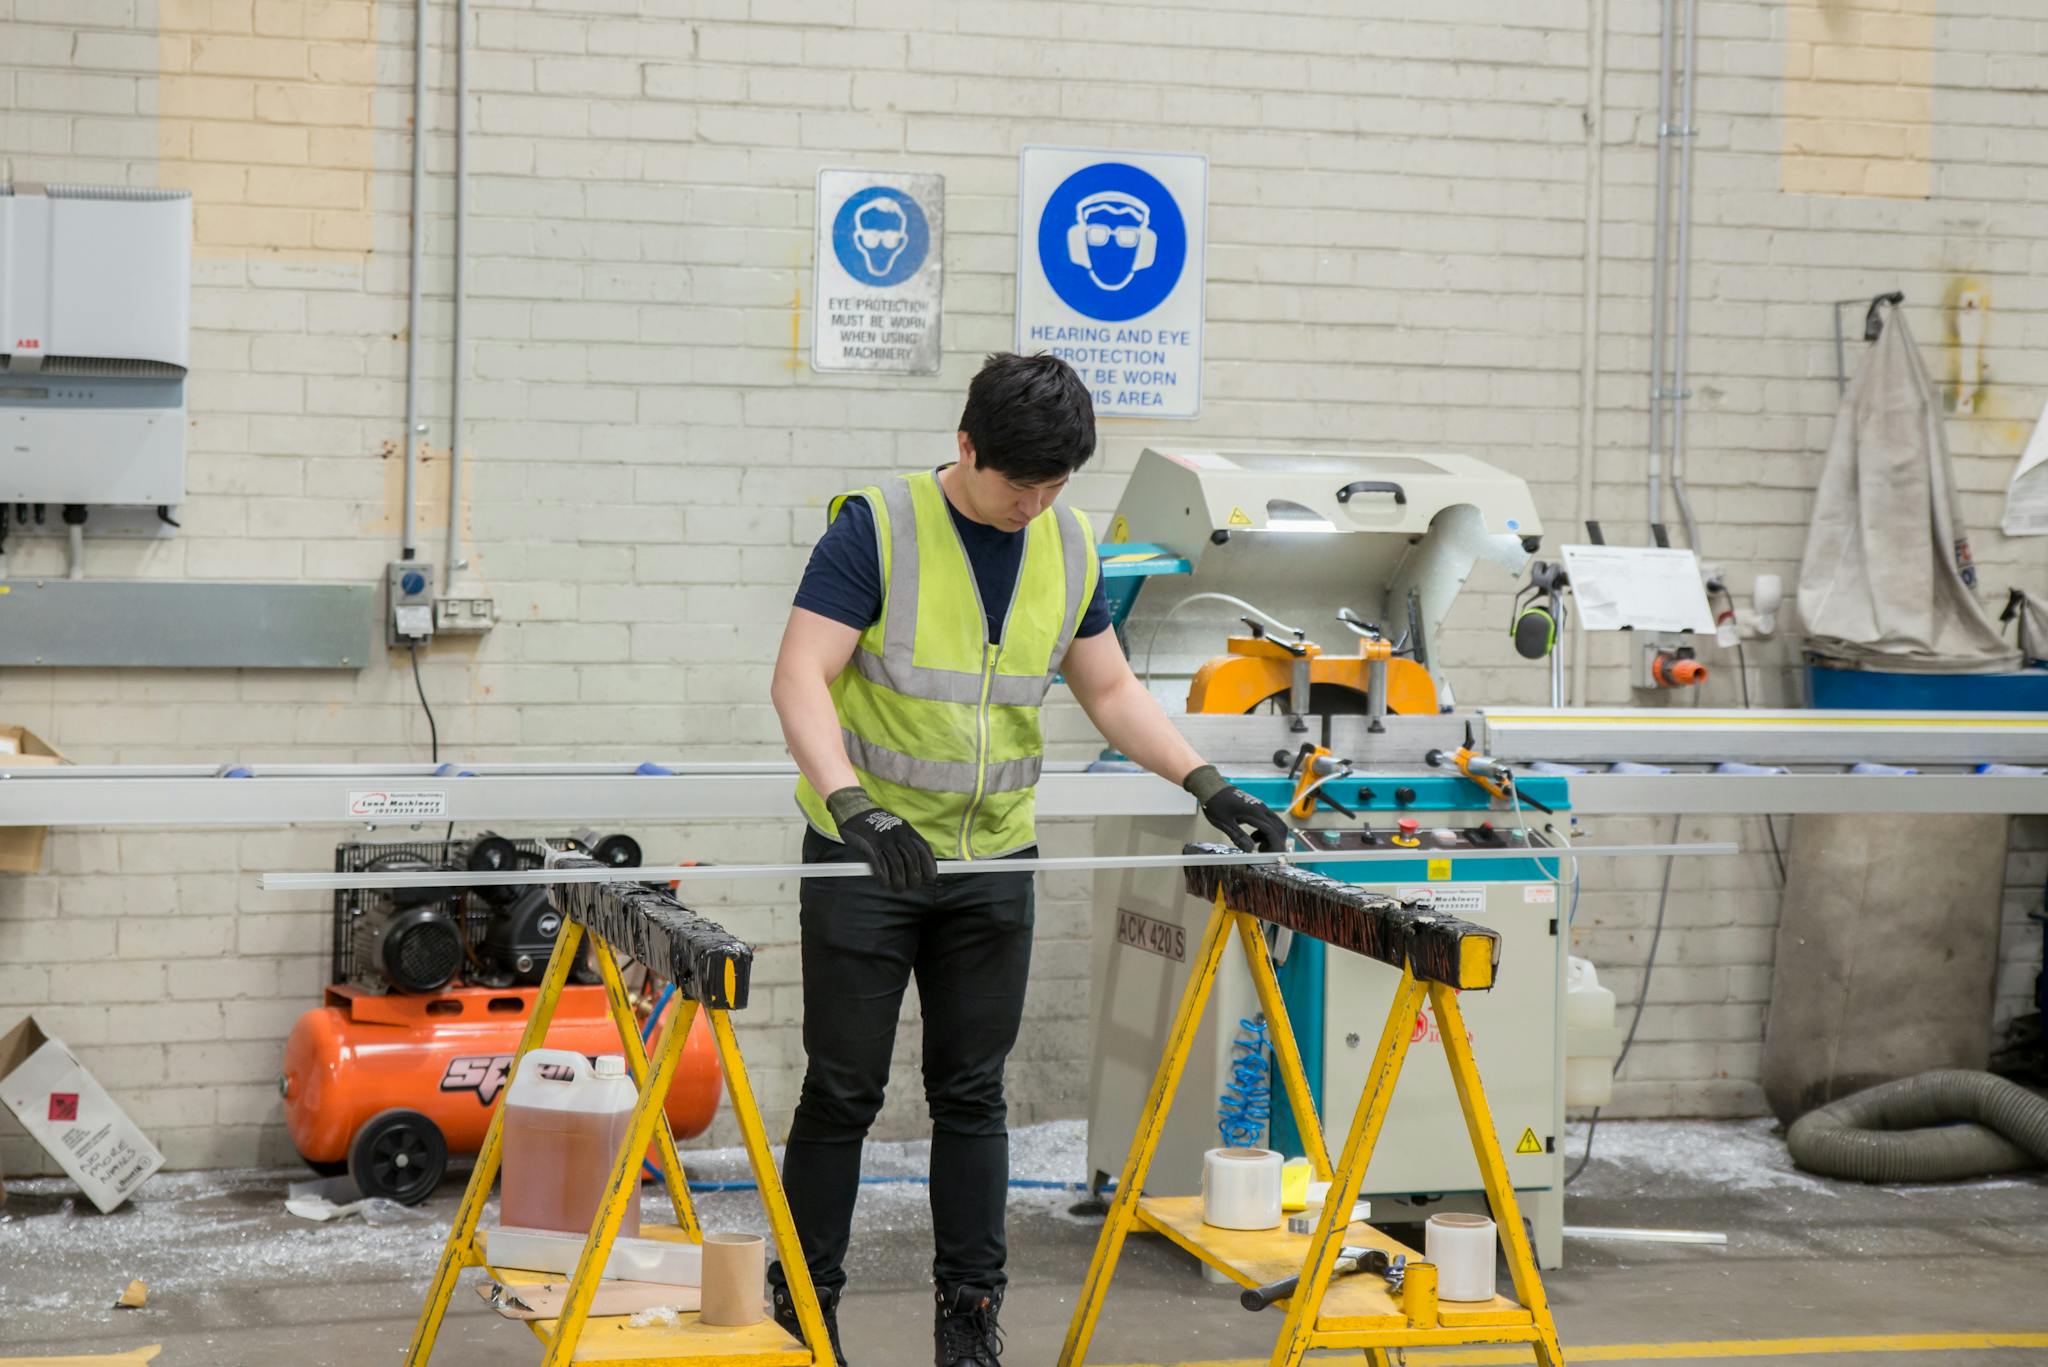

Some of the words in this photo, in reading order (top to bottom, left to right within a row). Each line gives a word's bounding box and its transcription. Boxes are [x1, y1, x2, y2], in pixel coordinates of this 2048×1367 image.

[829, 297, 851, 311] EYE
[856, 298, 929, 313] PROTECTION
[831, 314, 864, 327] MUST
[870, 315, 885, 329] BE
[890, 316, 926, 329] WORN
[840, 331, 876, 343] WHEN
[881, 331, 919, 345] USING
[1030, 325, 1111, 343] HEARING
[1116, 328, 1152, 345] AND
[1158, 329, 1191, 346] EYE
[843, 346, 912, 360] MACHINERY
[1052, 347, 1165, 365] PROTECTION
[1095, 369, 1117, 385] BE
[1124, 370, 1177, 386] WORN
[1117, 391, 1164, 406] AREA
[1119, 913, 1147, 947] ACK
[1150, 922, 1172, 954] 420
[1175, 930, 1184, 958] S
